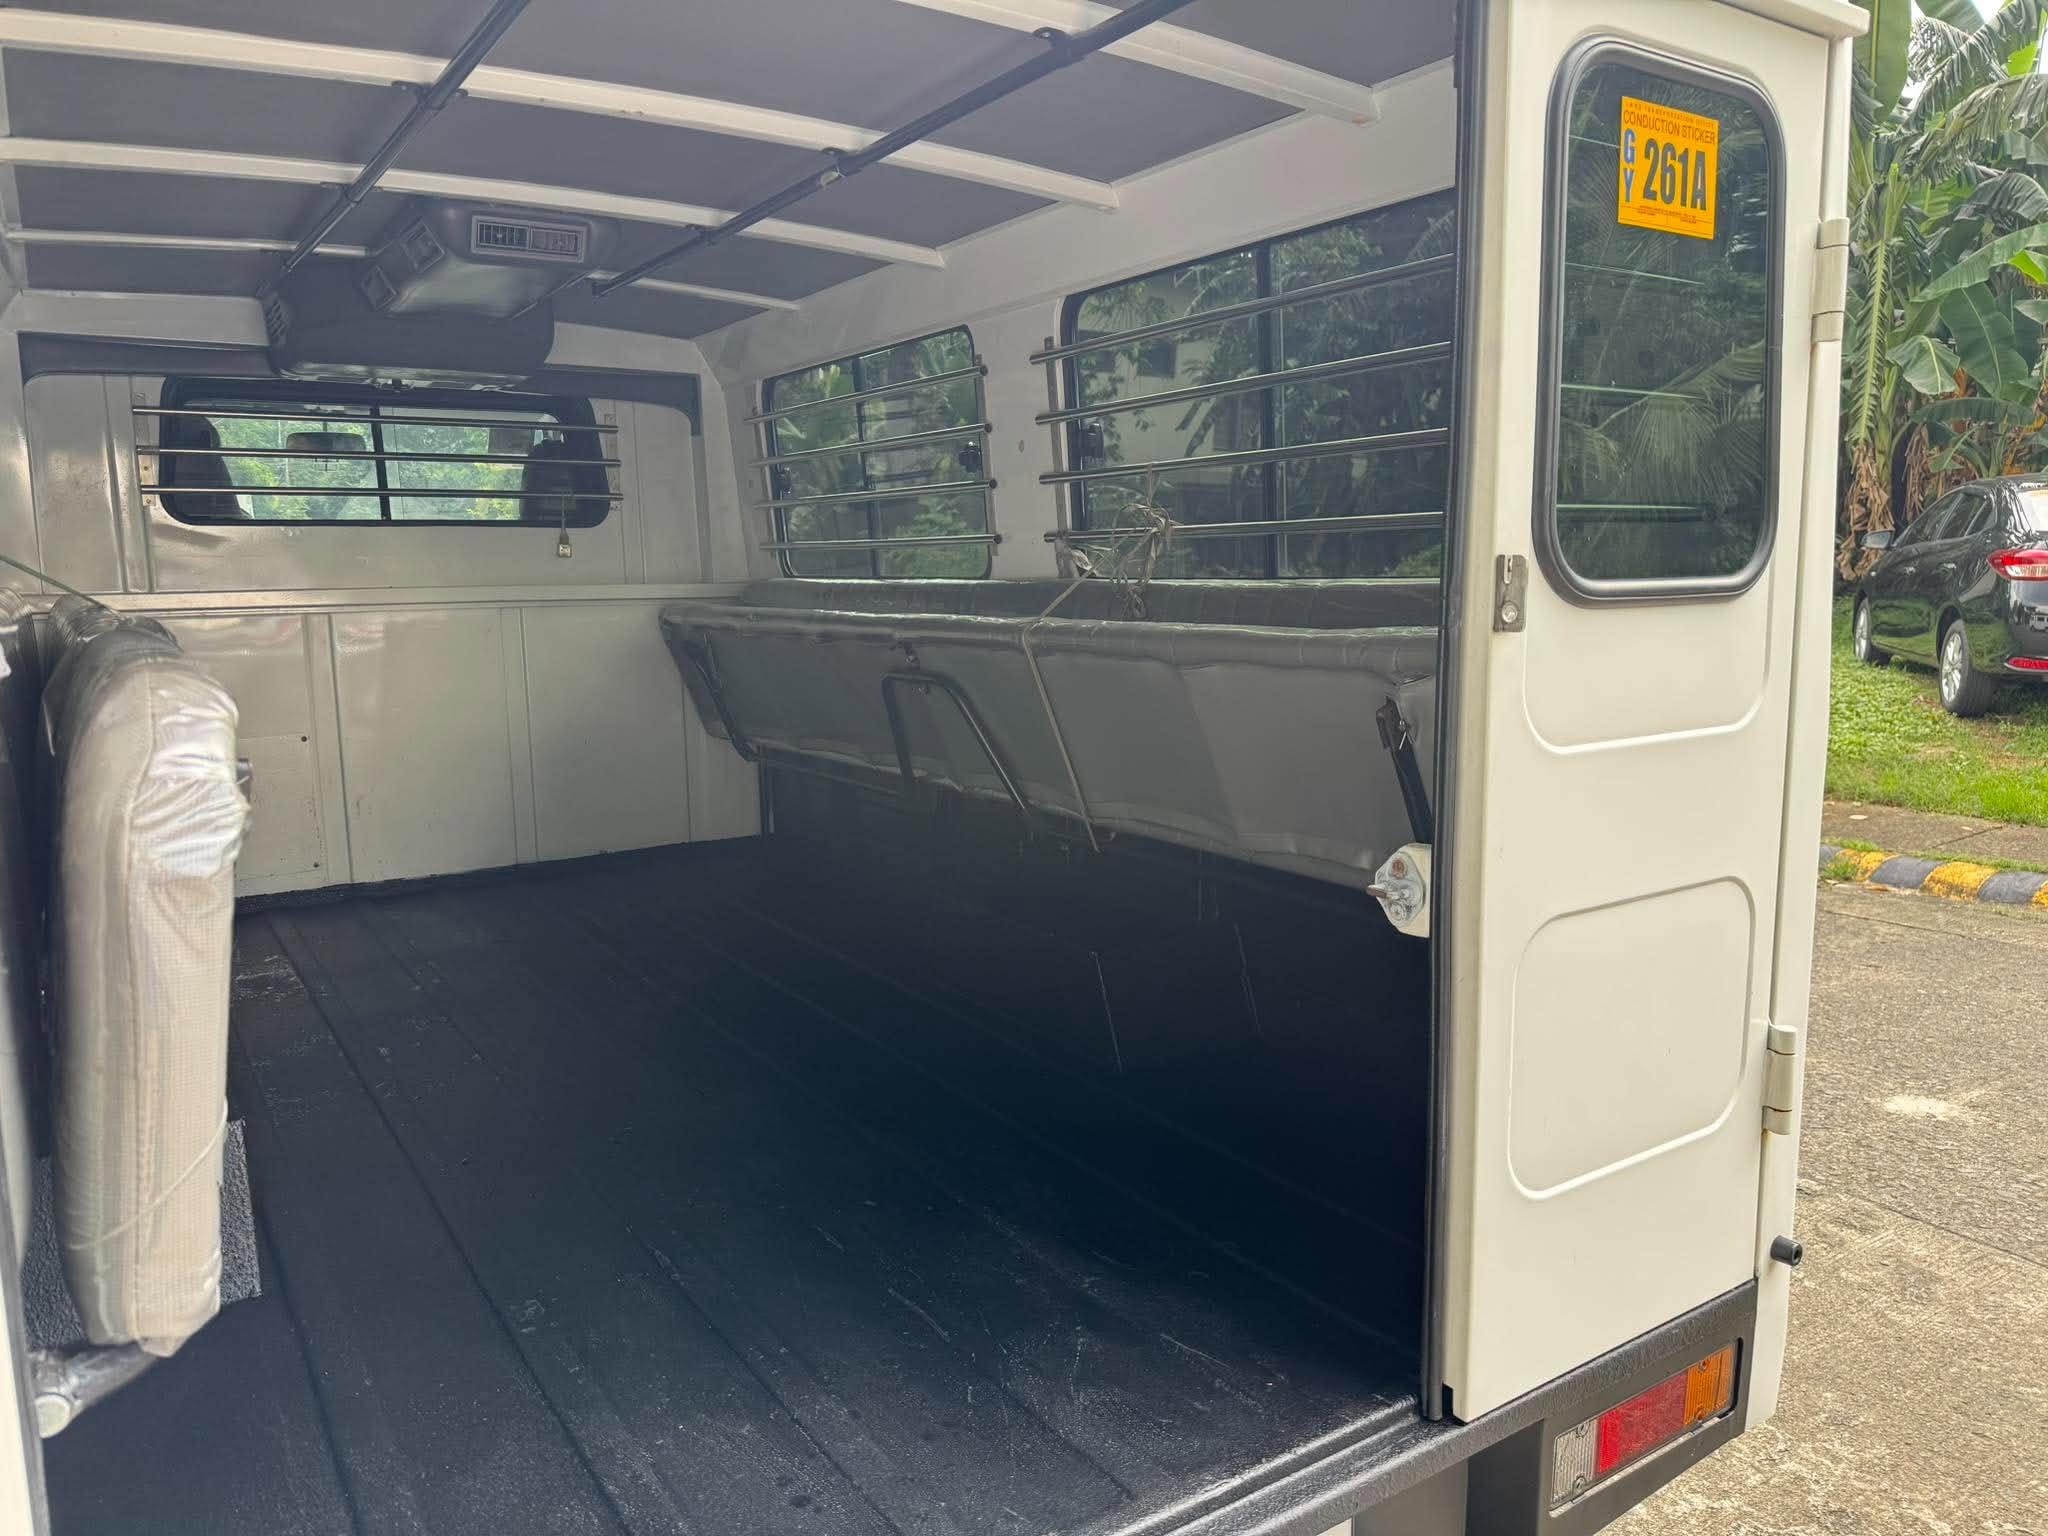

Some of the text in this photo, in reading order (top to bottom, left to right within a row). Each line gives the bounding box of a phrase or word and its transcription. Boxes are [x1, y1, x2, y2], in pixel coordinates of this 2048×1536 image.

[1623, 110, 1680, 136] CONDUCTION
[1681, 125, 1715, 144] STICKER
[1643, 138, 1707, 211] 261A
